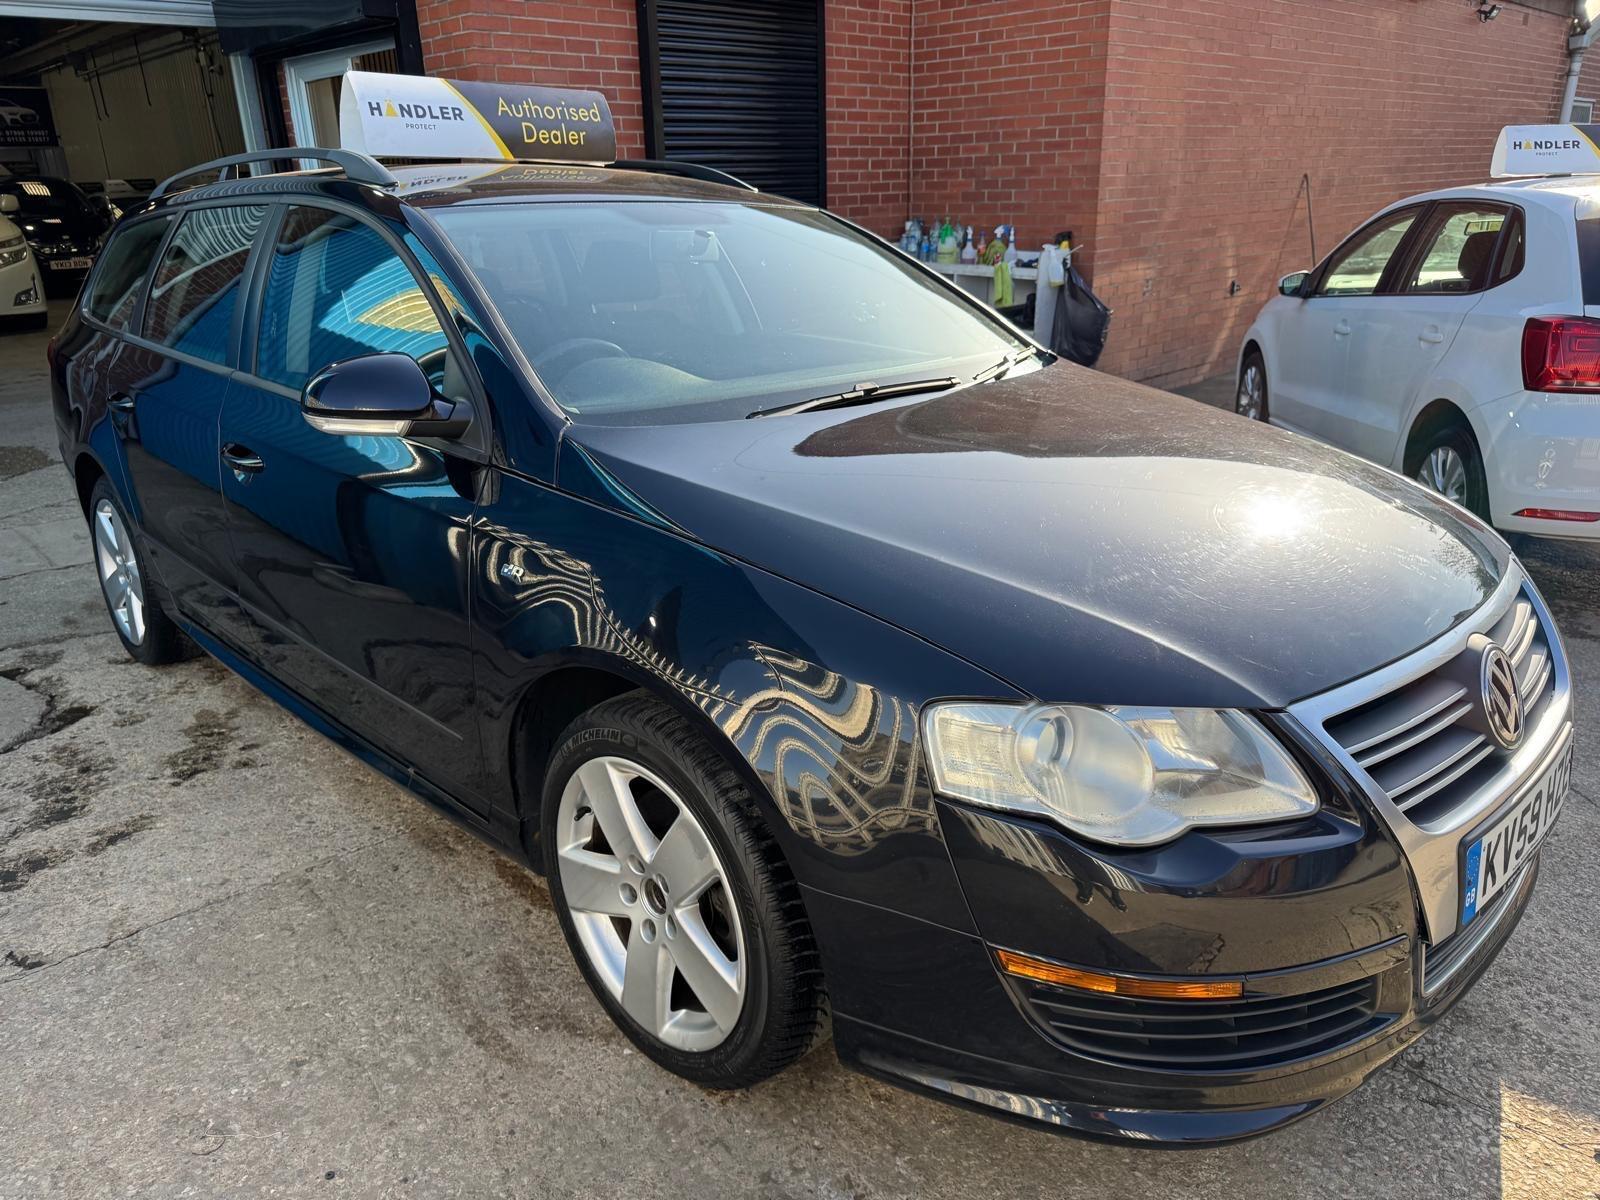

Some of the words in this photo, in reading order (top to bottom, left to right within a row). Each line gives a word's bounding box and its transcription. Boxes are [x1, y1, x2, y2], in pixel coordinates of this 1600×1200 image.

[498, 96, 601, 123] Authorised
[405, 122, 437, 130] PROTECT
[522, 121, 586, 145] Dealer
[571, 727, 621, 750] MICHELIN
[1482, 788, 1543, 898] KV59
[1465, 887, 1476, 907] GB
